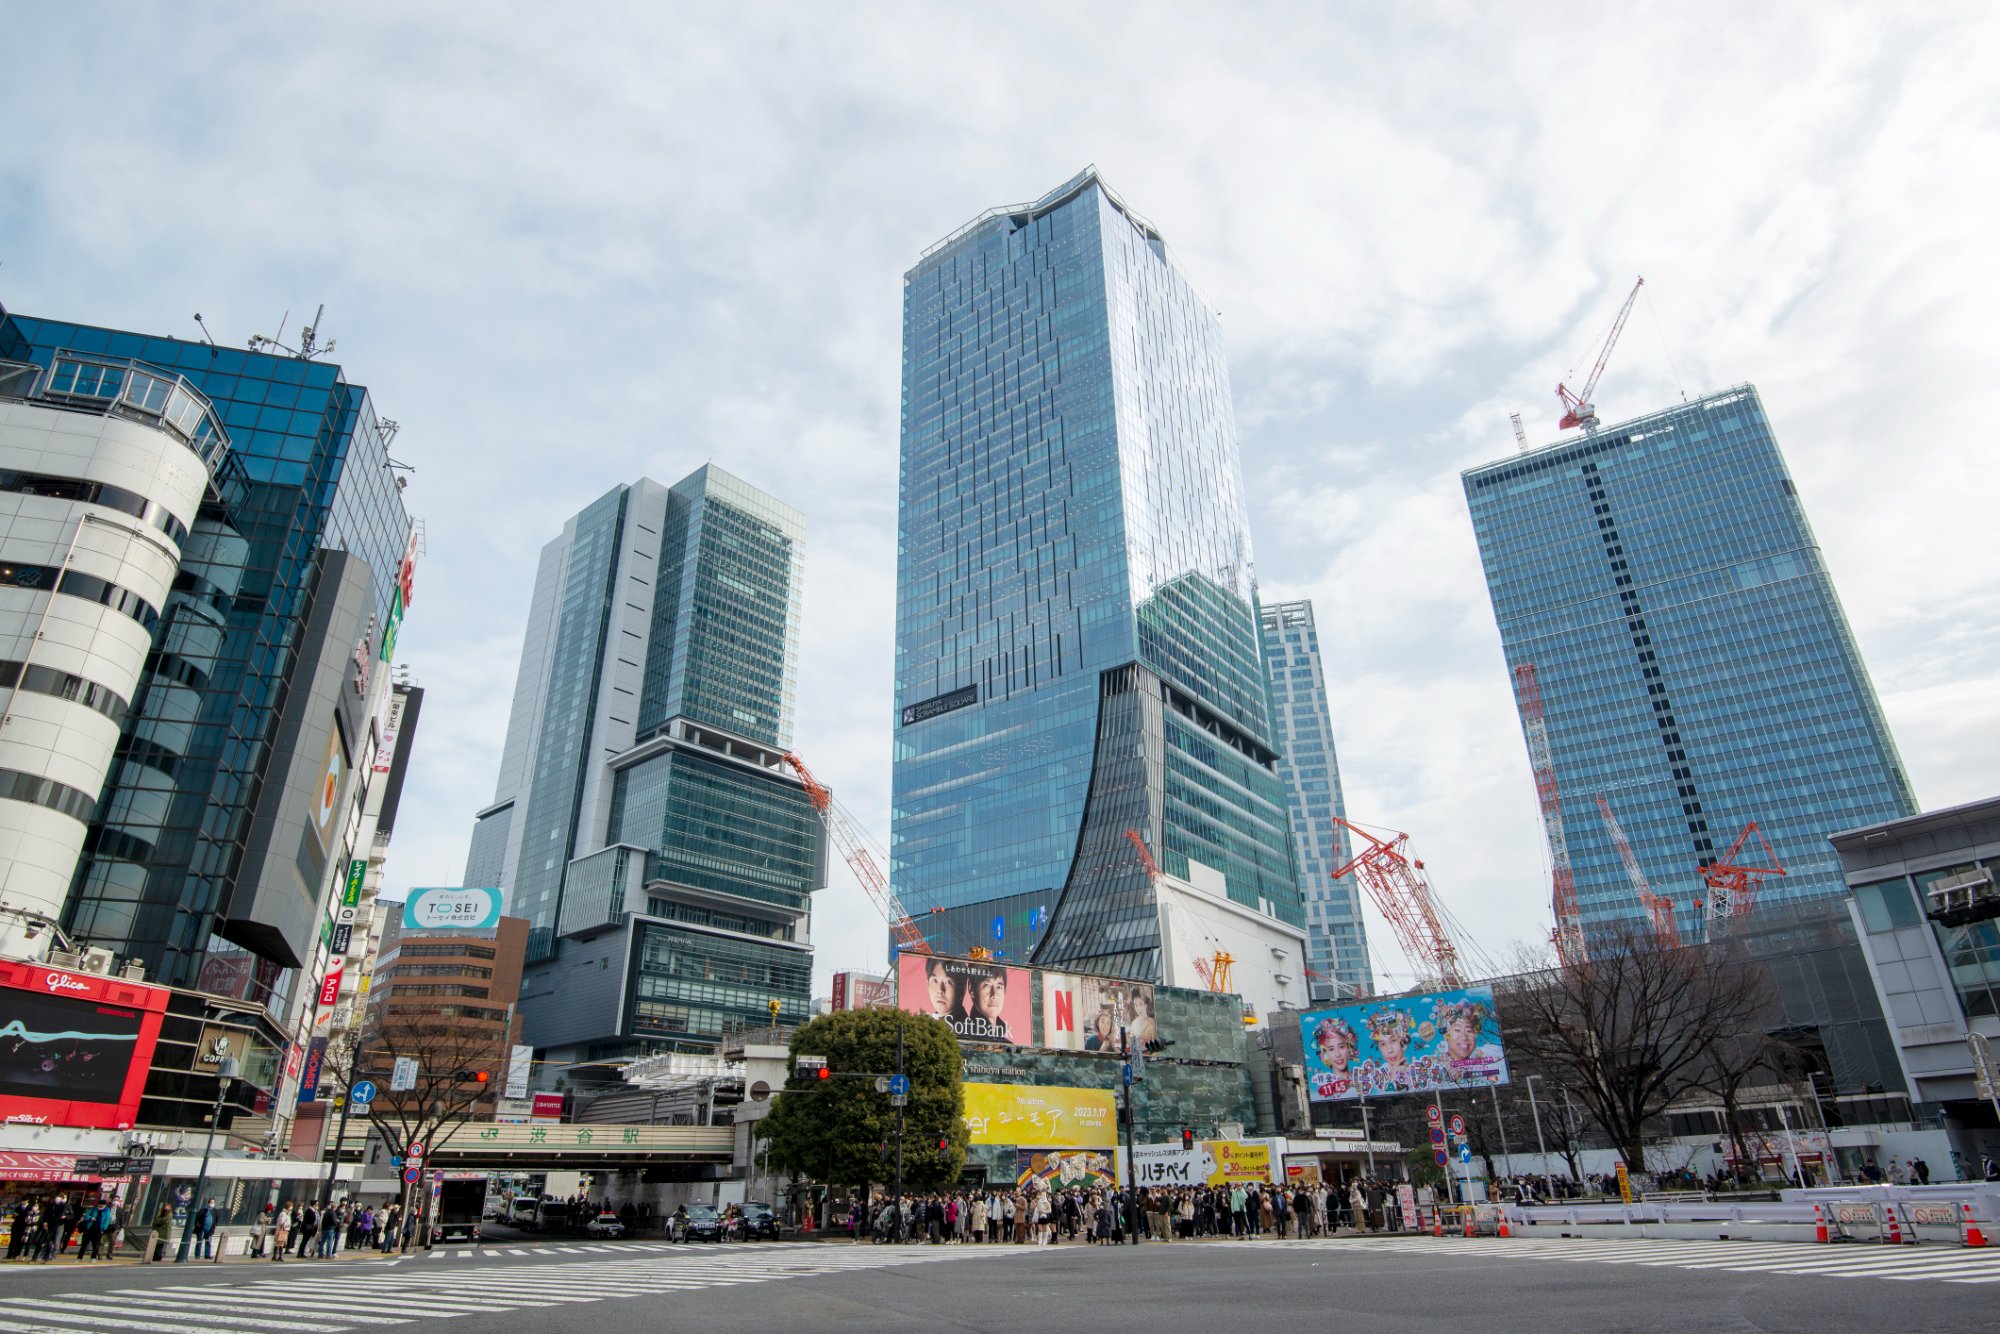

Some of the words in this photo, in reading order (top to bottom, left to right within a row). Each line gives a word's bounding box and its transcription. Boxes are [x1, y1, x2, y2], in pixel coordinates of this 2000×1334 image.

[915, 699, 943, 713] SHIBUYA
[915, 703, 949, 720] SCRAMBLE
[949, 694, 976, 709] SQUARE
[429, 903, 479, 913] TOSEI
[46, 973, 90, 991] Glico
[323, 978, 337, 1002] アコム
[1055, 990, 1074, 1032] N
[943, 1014, 1013, 1039] SoftBank
[970, 1065, 1000, 1075] shibuya
[1001, 1067, 1026, 1076] station
[1074, 1106, 1107, 1118] 2023.1.17
[480, 1128, 499, 1140] JR
[529, 1126, 639, 1145] 渋谷駅
[1142, 1161, 1190, 1181] ハチペイ
